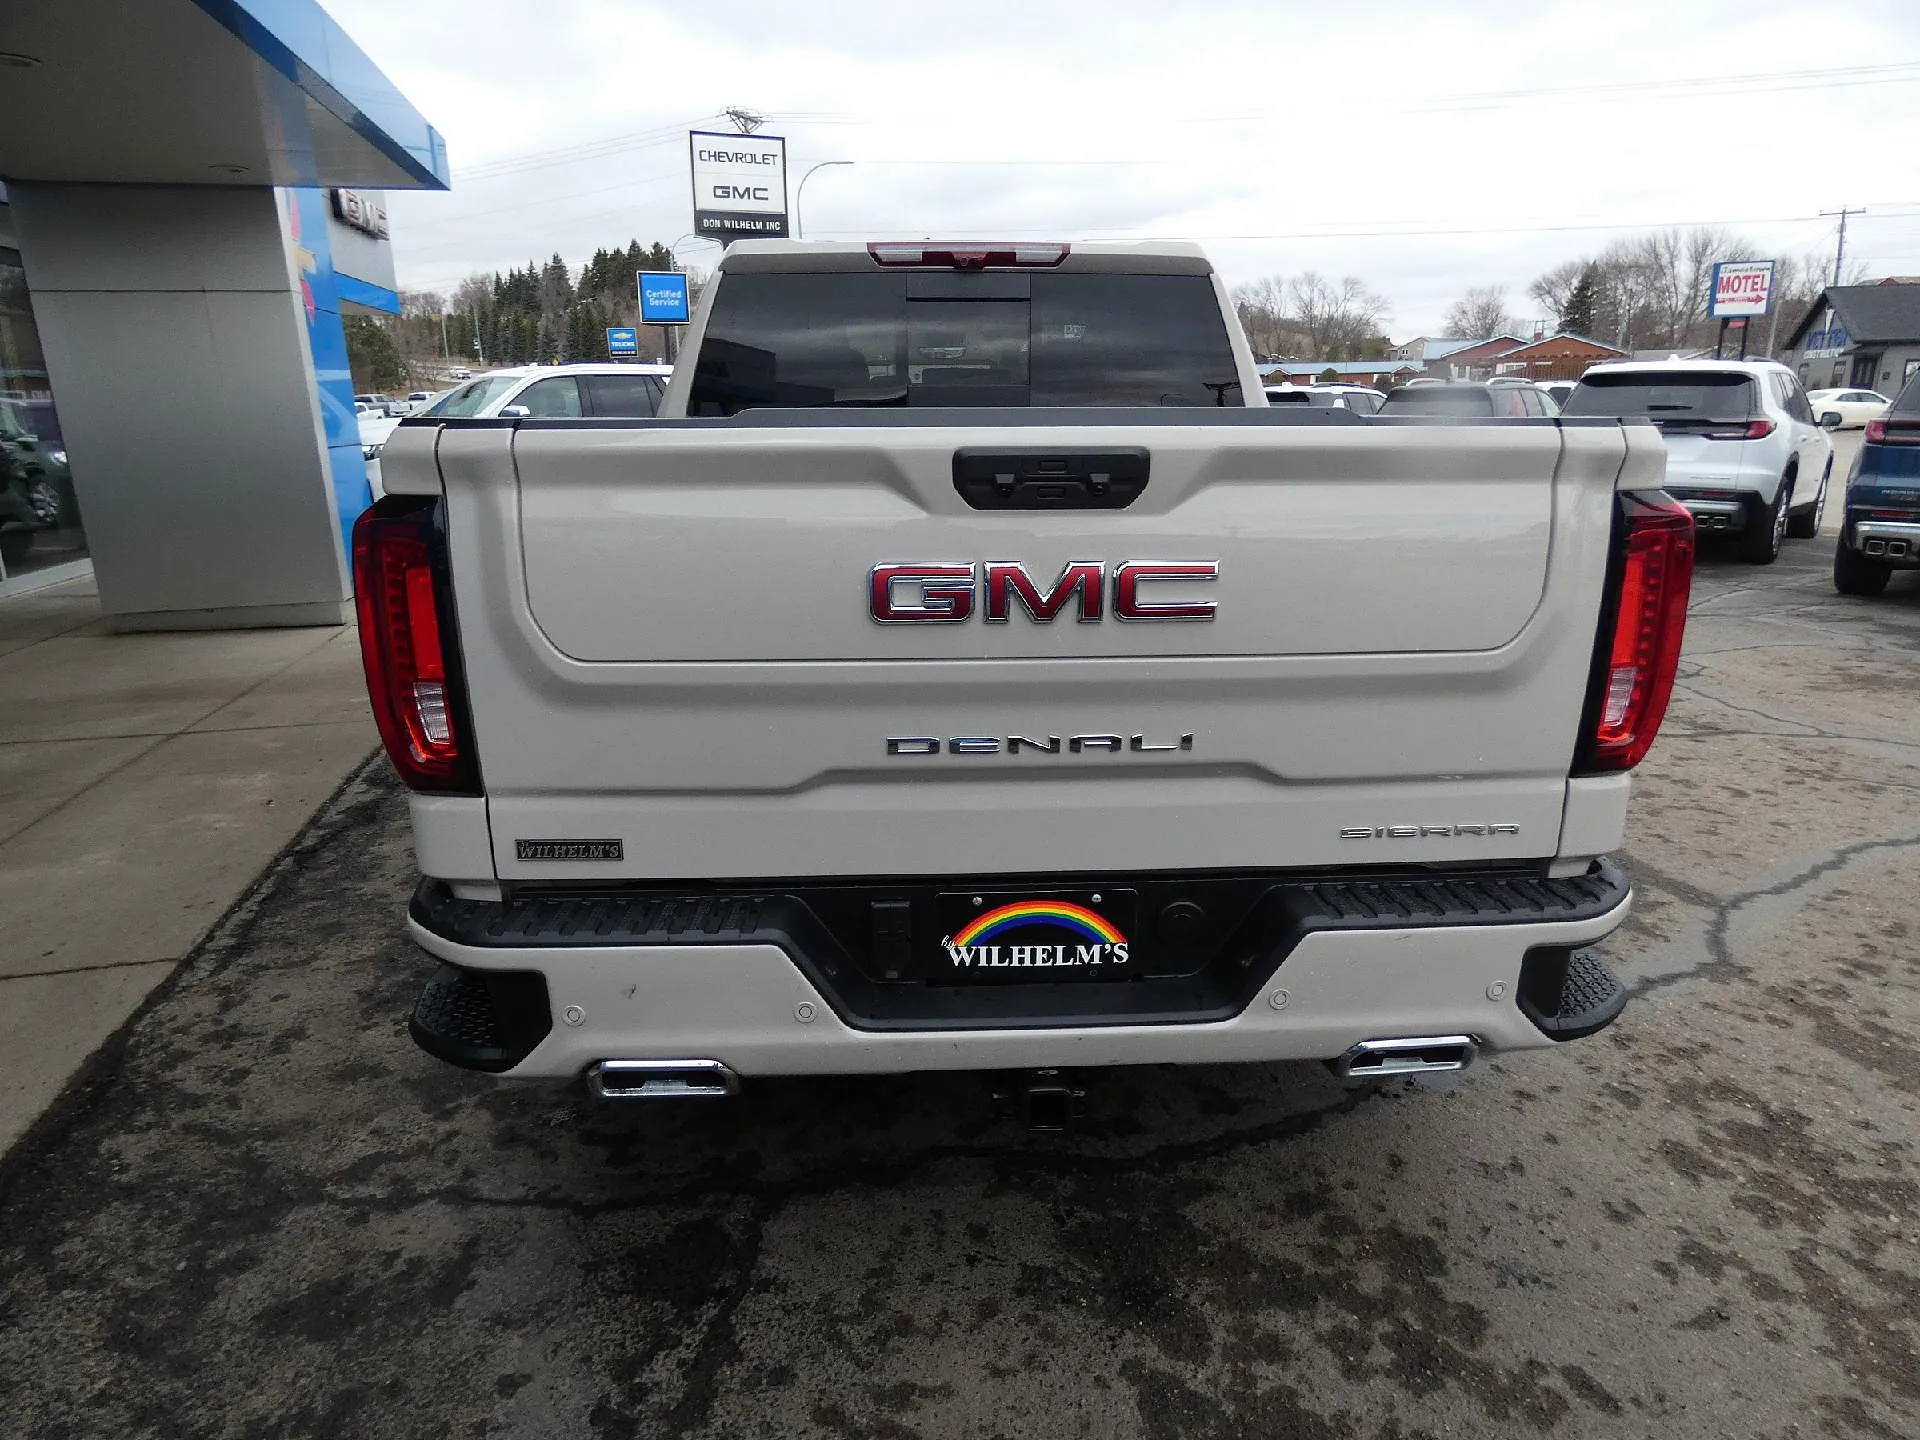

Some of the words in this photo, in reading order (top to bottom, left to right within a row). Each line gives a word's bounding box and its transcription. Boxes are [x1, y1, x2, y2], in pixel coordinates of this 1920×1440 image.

[699, 149, 778, 166] CHEVROLET
[713, 185, 769, 201] GMC
[703, 218, 721, 229] DON
[723, 219, 764, 231] WILHELM
[765, 220, 781, 231] INC
[1717, 274, 1768, 294] MOTEL
[645, 289, 682, 299] Certified
[649, 298, 680, 307] Service
[869, 560, 1220, 624] GMC
[886, 732, 1195, 755] DENALI
[1340, 823, 1520, 839] SIERRA
[519, 845, 619, 859] WILHELM'S
[949, 942, 1129, 967] WILHELM'S
